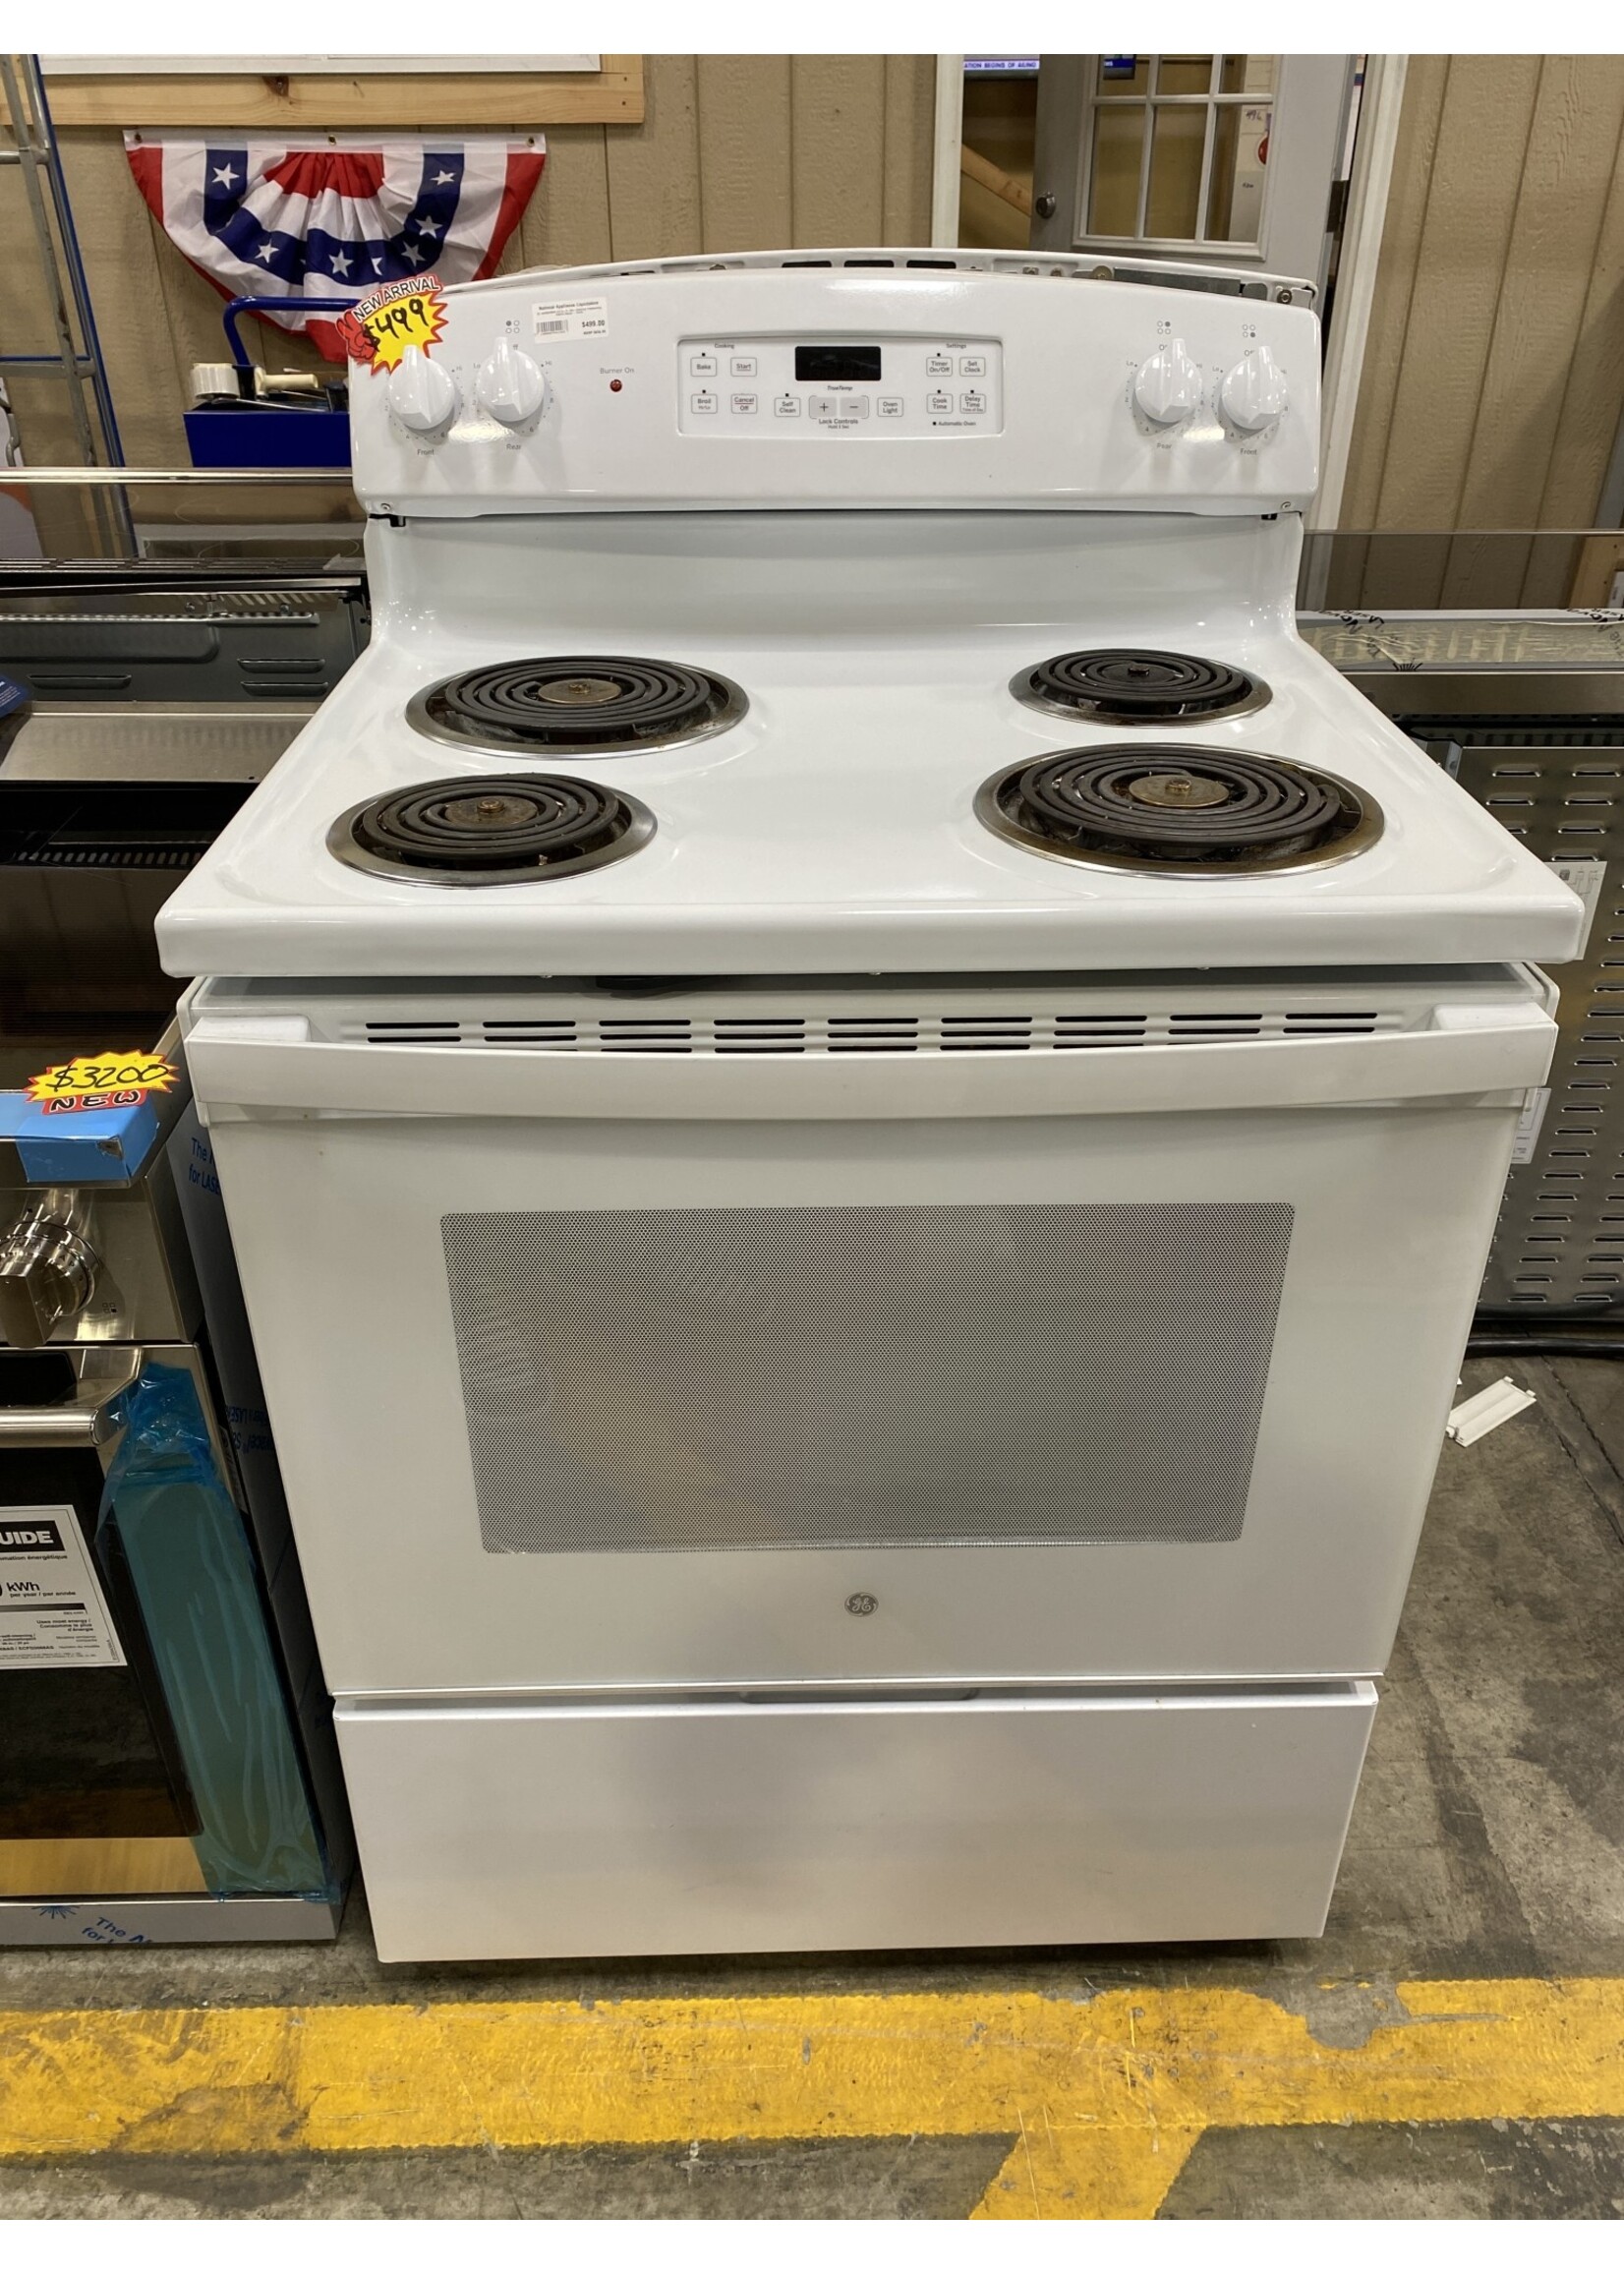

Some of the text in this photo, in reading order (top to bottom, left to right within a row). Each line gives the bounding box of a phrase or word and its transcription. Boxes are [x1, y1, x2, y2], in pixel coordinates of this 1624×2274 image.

[353, 276, 439, 321] NEW ARRIVAL
[363, 298, 429, 352] $499
[46, 1064, 169, 1092] $3200
[50, 1090, 140, 1111] NEW
[191, 1137, 207, 1161] The
[189, 1163, 201, 1184] for
[6, 1582, 40, 1591] kWh
[82, 1927, 105, 1941] for
[96, 1917, 126, 1937] The
